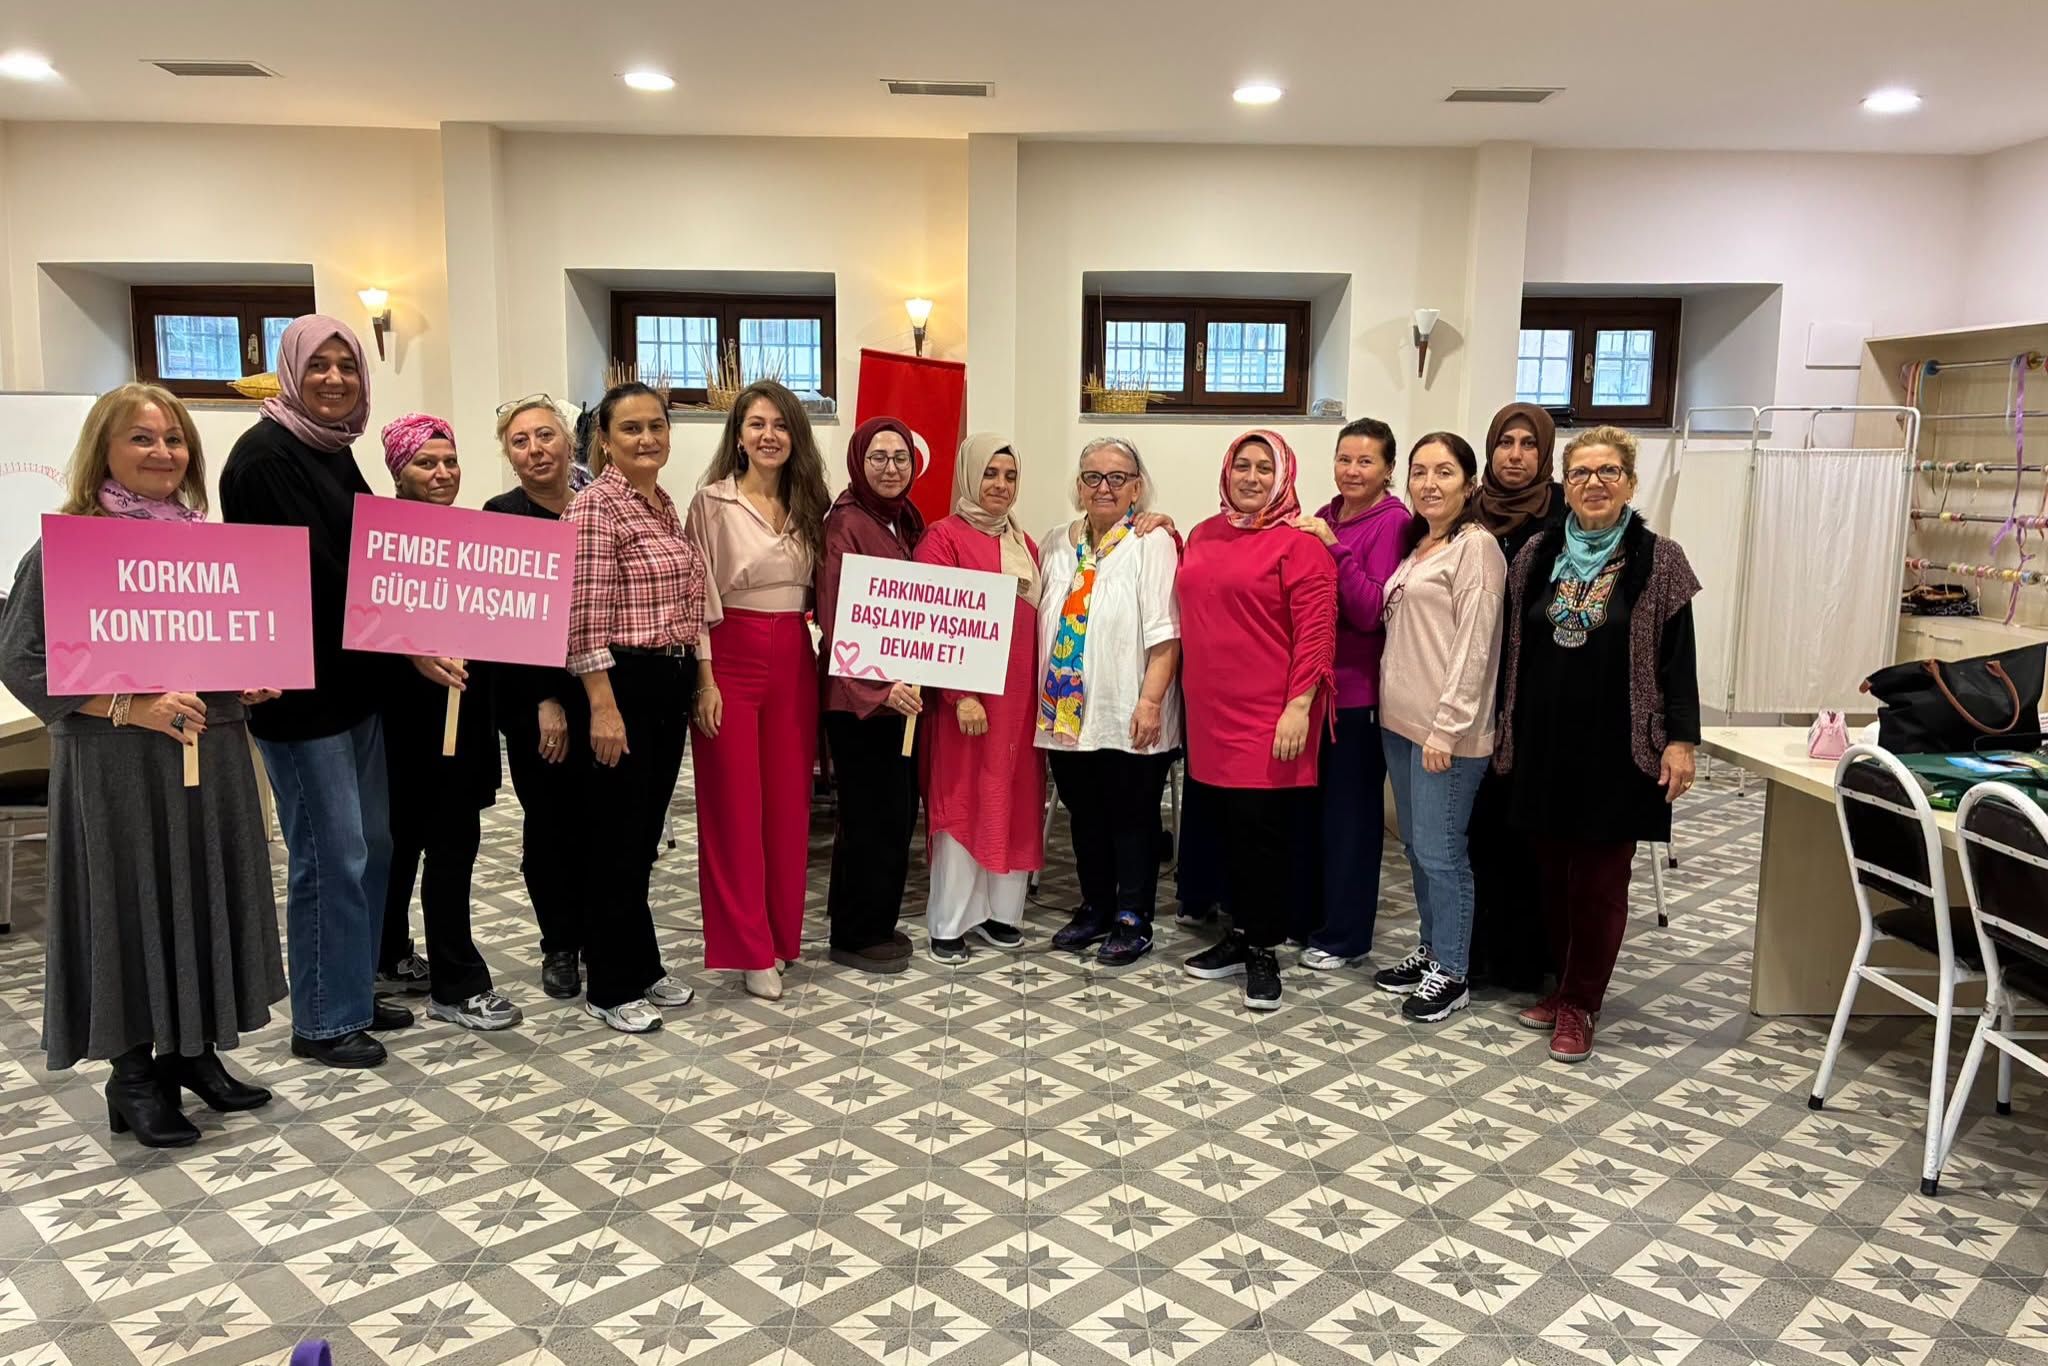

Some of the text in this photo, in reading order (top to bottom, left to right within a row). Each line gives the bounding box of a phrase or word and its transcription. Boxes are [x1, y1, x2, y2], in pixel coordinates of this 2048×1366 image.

[367, 530, 561, 581] PEMBE KURDELE
[118, 559, 240, 594] KORKMA
[868, 576, 986, 611] FARKINDALIKLA
[371, 572, 550, 621] GÜÇLÜ YAŞAM !
[89, 608, 276, 643] KONTROL ET !
[850, 603, 999, 641] BAŞLAYIP YAŞAMLA
[879, 636, 965, 665] DEVAM ET !
